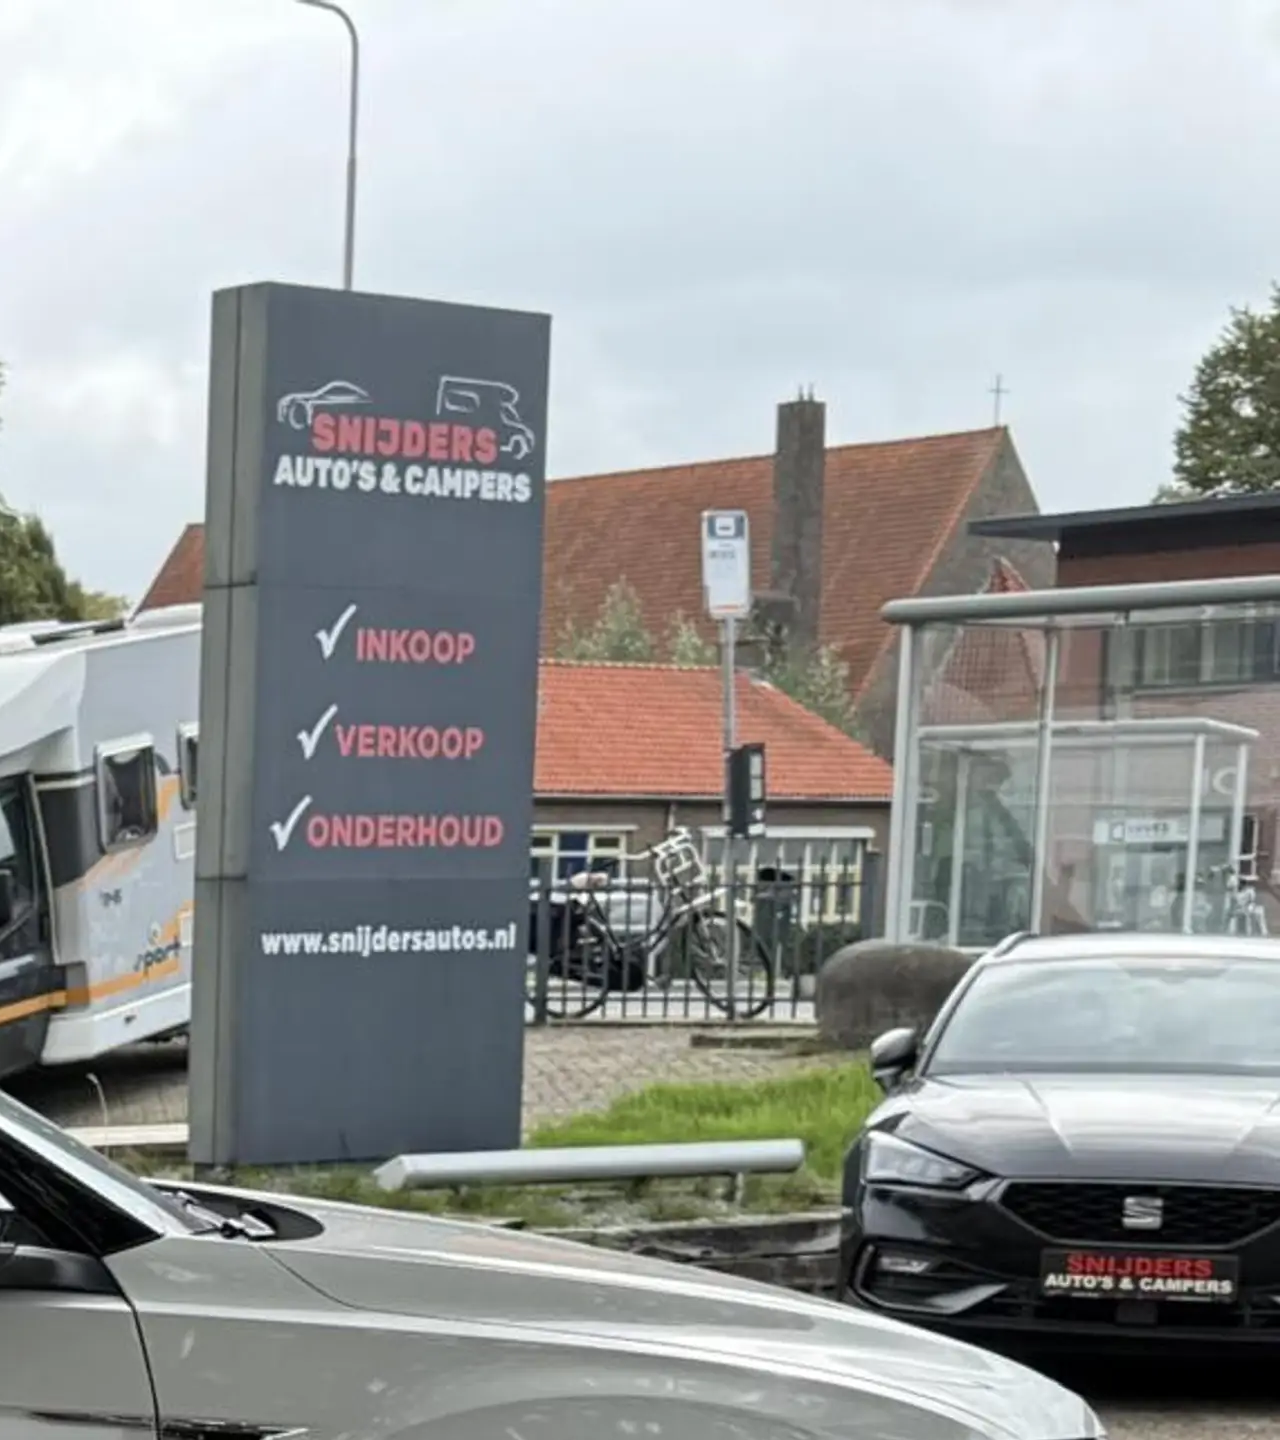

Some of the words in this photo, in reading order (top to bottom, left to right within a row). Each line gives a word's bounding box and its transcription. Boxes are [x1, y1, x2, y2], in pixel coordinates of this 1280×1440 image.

[311, 412, 499, 464] SNIJDERS
[273, 454, 378, 493] AUTO'S
[379, 461, 401, 494] &
[403, 464, 532, 502] CAMPERS
[355, 628, 475, 663] INKOOP
[335, 724, 484, 759] VERKOOP
[306, 814, 505, 847] ONDERHOUD
[261, 923, 517, 958] www.snijdersautos.nl
[1067, 1253, 1213, 1278] SNIJDERS
[1044, 1273, 1114, 1290] AUTO'S
[1118, 1276, 1134, 1290] &
[1139, 1277, 1233, 1294] CAMPERS
